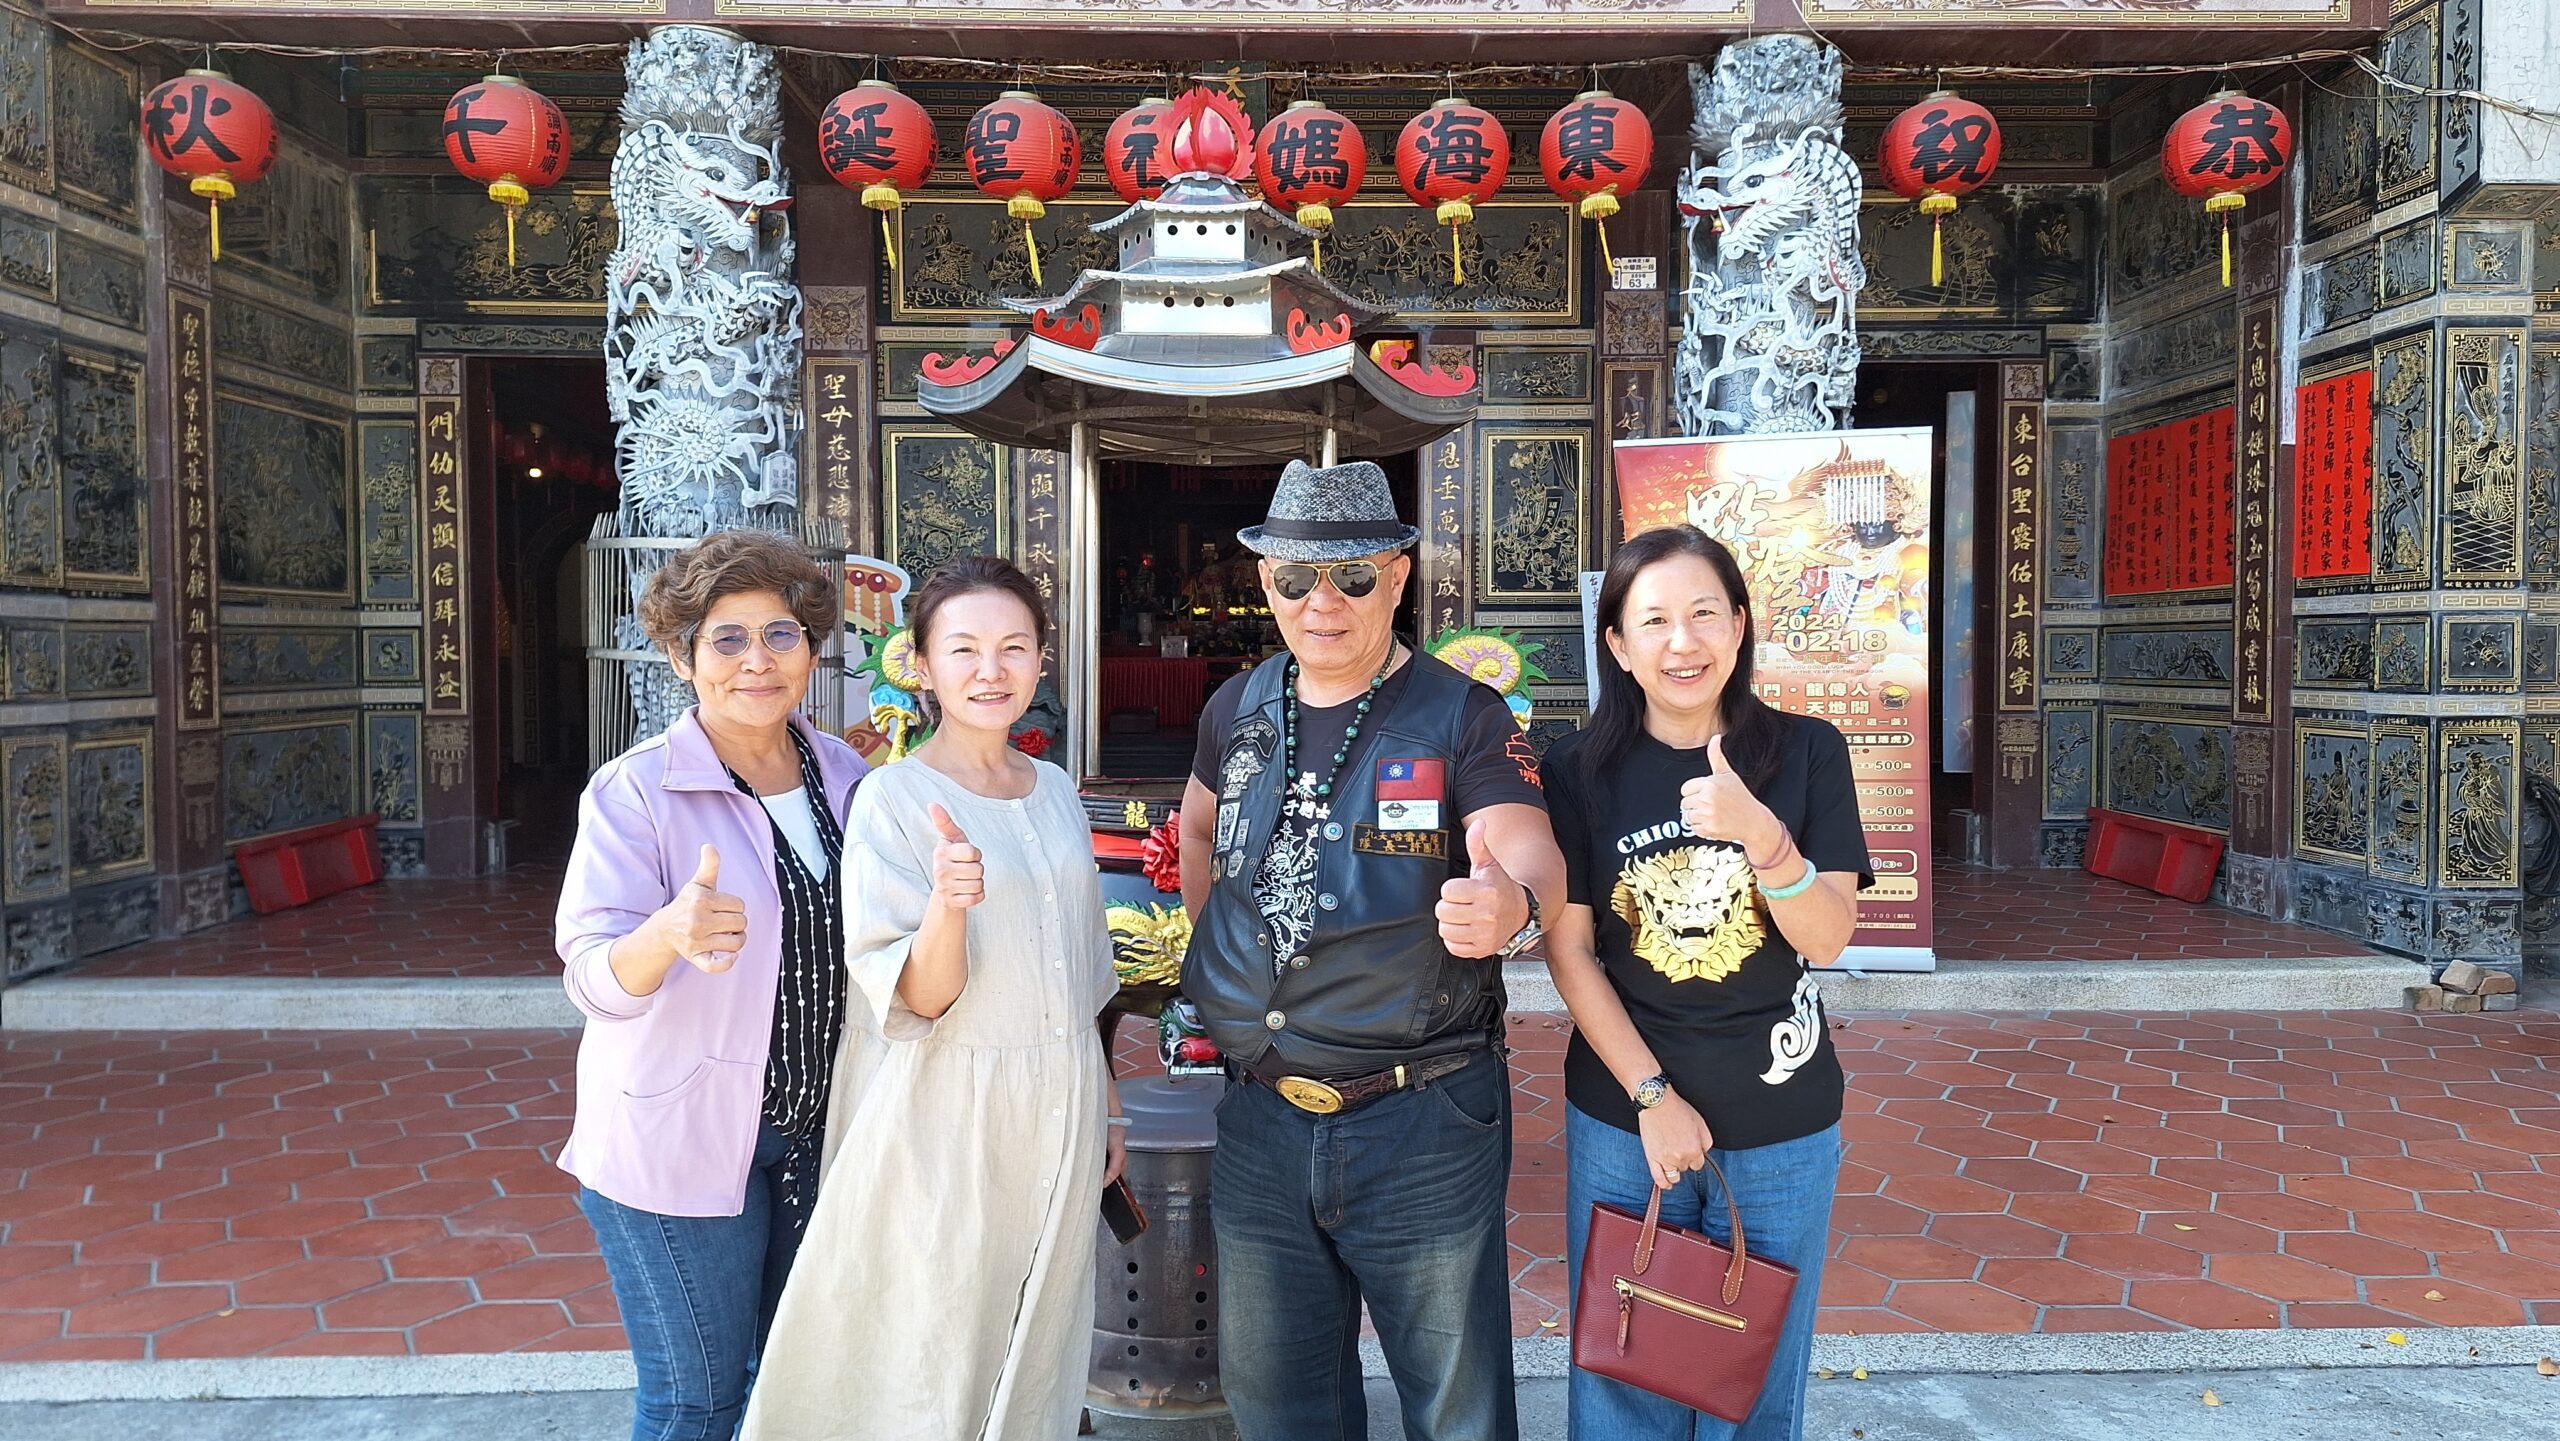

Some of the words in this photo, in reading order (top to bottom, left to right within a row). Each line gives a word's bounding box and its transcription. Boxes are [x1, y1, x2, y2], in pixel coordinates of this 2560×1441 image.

[144, 84, 242, 163] 秋
[443, 88, 508, 163] 千
[819, 102, 897, 173] 誕
[965, 108, 1025, 187] 聖
[1266, 119, 1350, 193] 媽
[1413, 110, 1494, 191] 海
[1557, 101, 1629, 182] 東
[1909, 107, 1993, 185] 祝
[2188, 101, 2287, 181] 恭
[1628, 278, 1642, 288] 63
[1770, 614, 1842, 631] 2024
[1785, 630, 1888, 652] 02.18
[1255, 722, 1275, 739] CHAPTER
[1123, 800, 1150, 828] 龍
